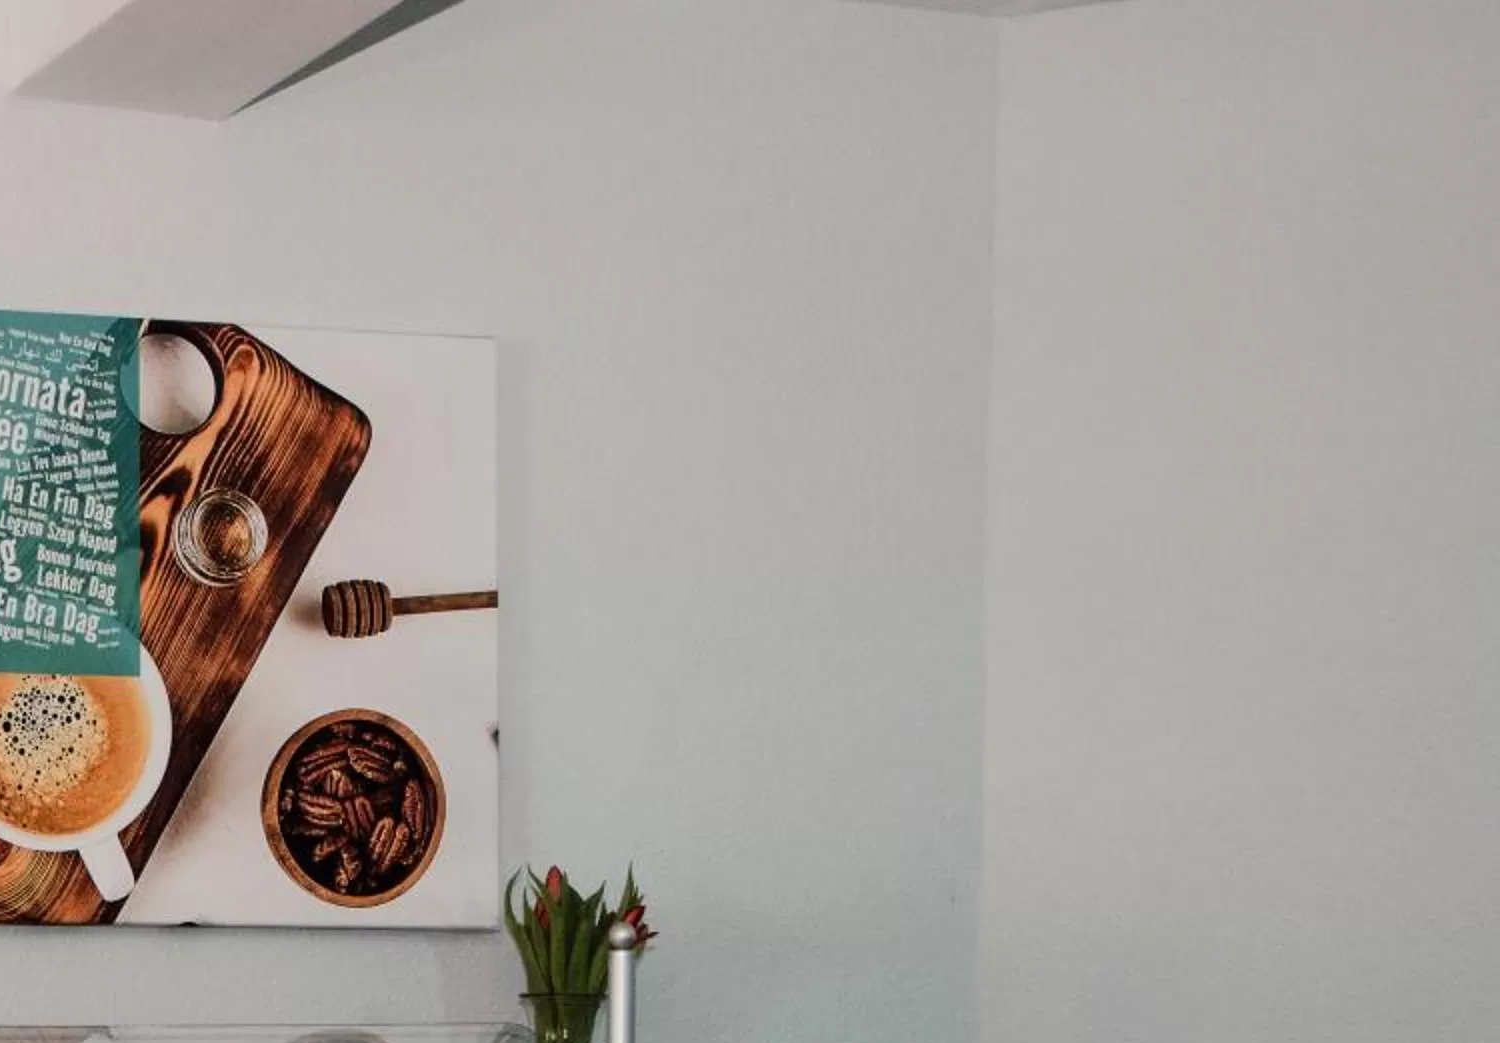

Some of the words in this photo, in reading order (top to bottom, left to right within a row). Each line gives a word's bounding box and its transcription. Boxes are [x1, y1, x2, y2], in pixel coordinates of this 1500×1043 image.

[3, 475, 24, 503] Ha
[30, 482, 48, 509] En
[54, 487, 78, 515] Fin
[84, 494, 116, 530] Dag
[78, 528, 117, 554] Napod
[37, 564, 85, 594] Lekker
[88, 575, 116, 606] Dag
[24, 593, 56, 628] Bra
[63, 601, 100, 644] Dag
